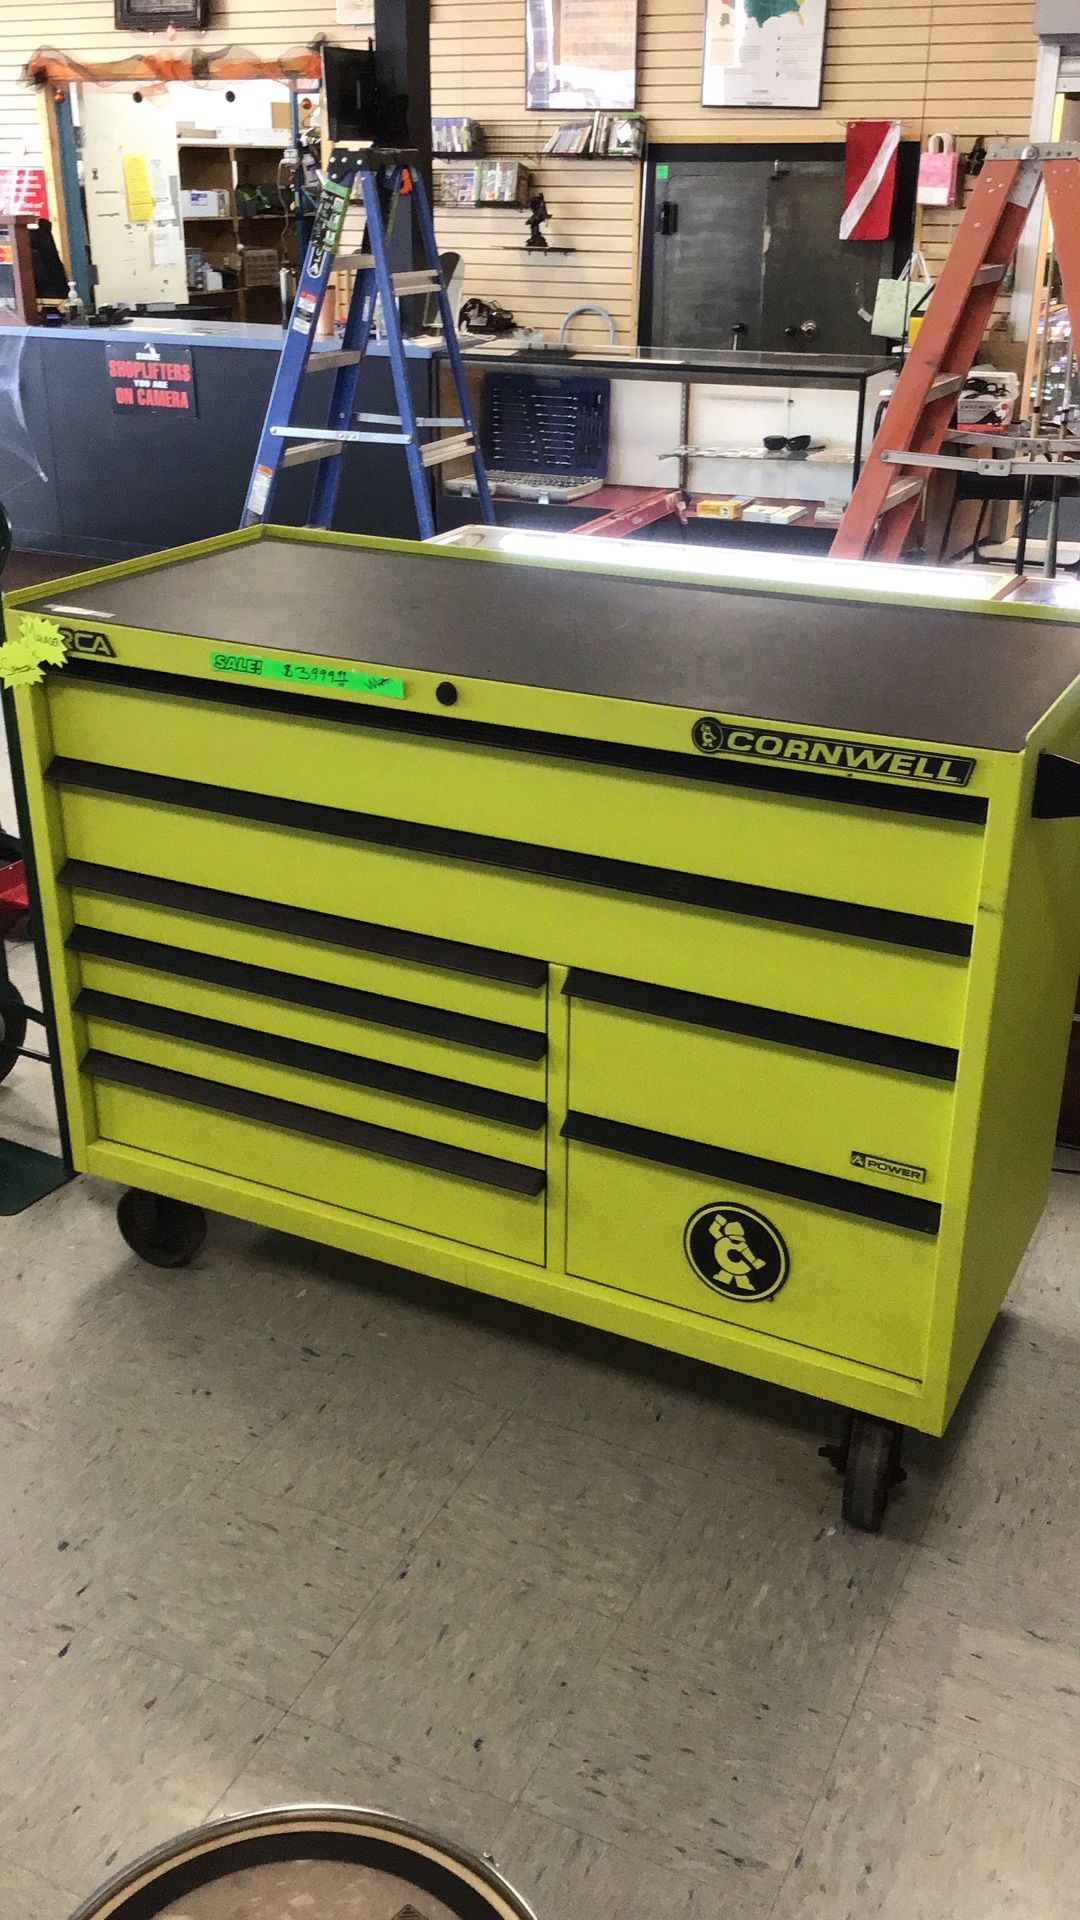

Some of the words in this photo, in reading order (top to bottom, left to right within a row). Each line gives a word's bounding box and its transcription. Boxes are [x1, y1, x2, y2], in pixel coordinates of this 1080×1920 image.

[109, 360, 191, 382] SHOPLIFTERS
[133, 380, 151, 388] YOU
[152, 381, 169, 389] ARE
[115, 387, 134, 405] ON
[137, 388, 189, 409] CAMERA
[213, 654, 264, 676] SALE!
[726, 730, 960, 783] CORNWELL
[867, 1160, 921, 1180] POWER
